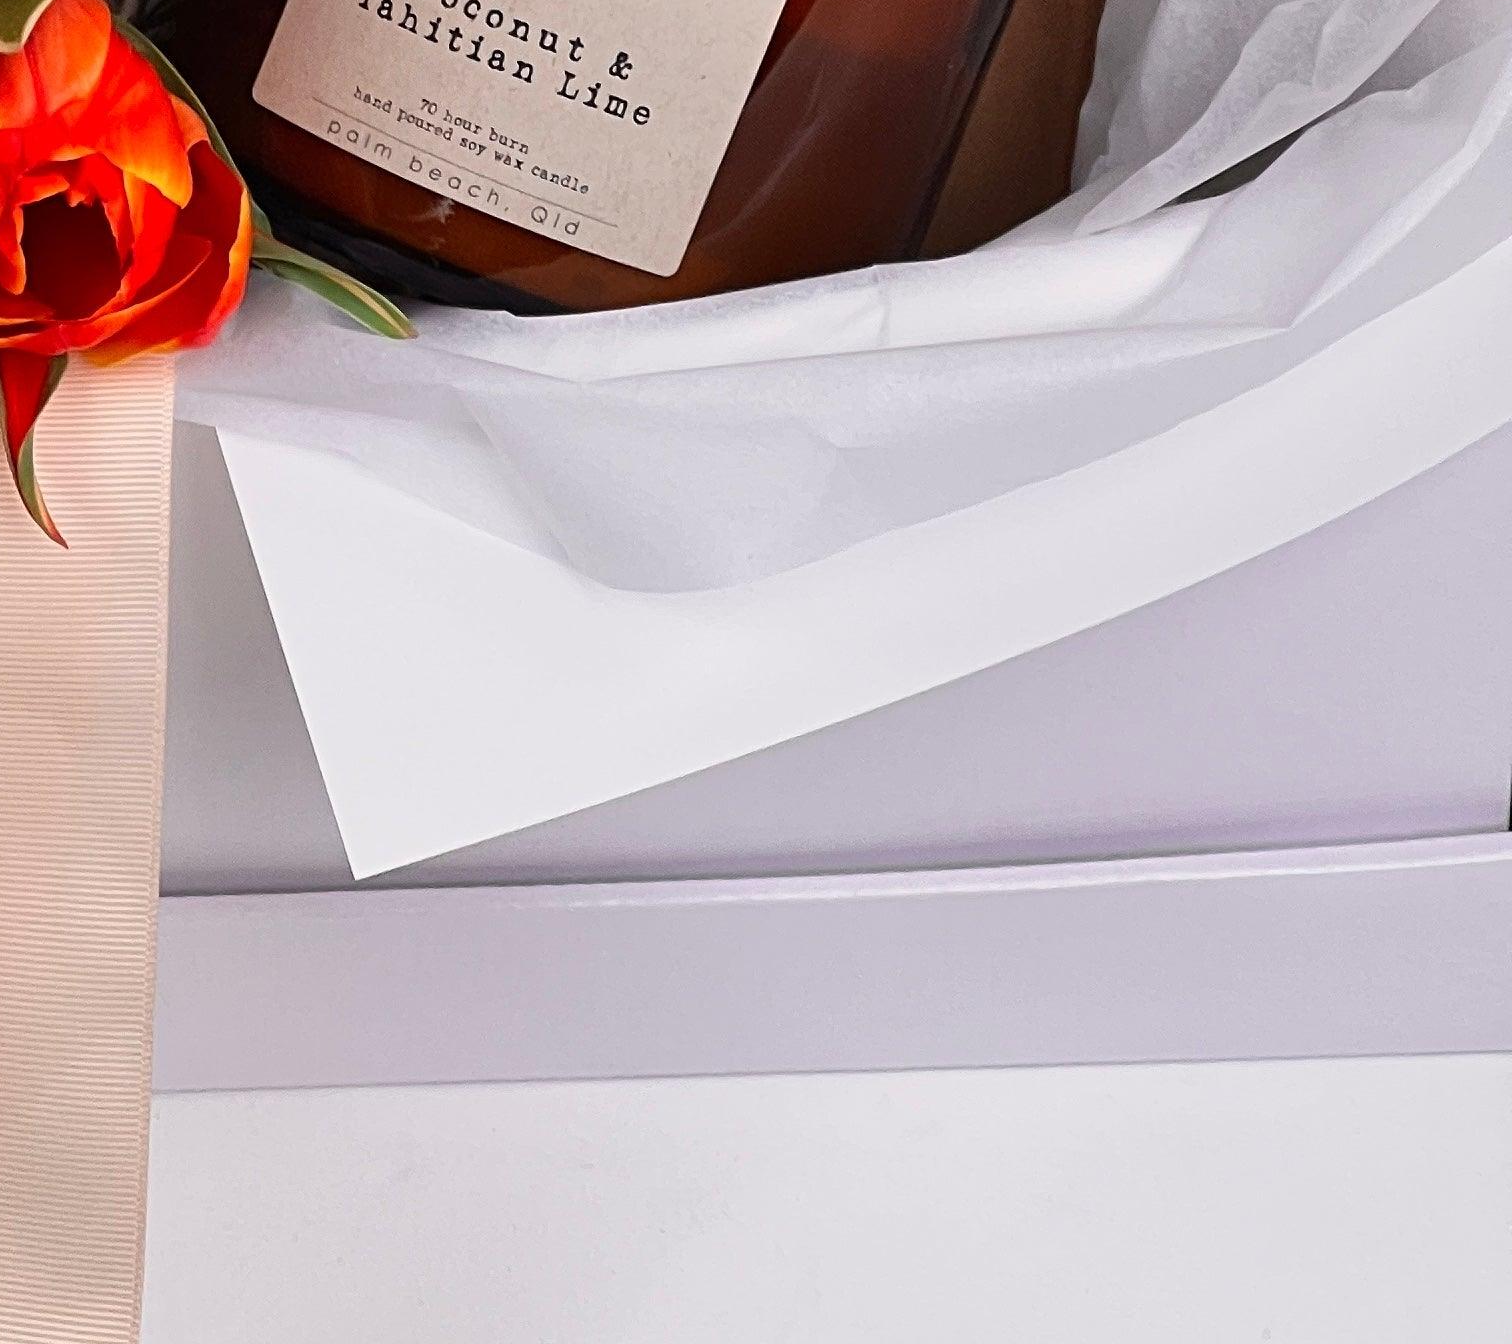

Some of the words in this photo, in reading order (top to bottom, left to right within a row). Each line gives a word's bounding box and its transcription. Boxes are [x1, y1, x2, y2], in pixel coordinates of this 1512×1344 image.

[608, 51, 634, 80] &
[420, 98, 439, 116] 70
[443, 109, 484, 136] hour
[488, 126, 530, 155] burn
[556, 70, 651, 126] Lime
[353, 86, 393, 114] hand
[397, 108, 454, 142] poured
[459, 135, 488, 157] soy
[494, 150, 525, 171] wax
[530, 165, 590, 195] candle
[326, 119, 393, 160] palm
[408, 155, 511, 212] beach,
[530, 205, 581, 237] Qld
